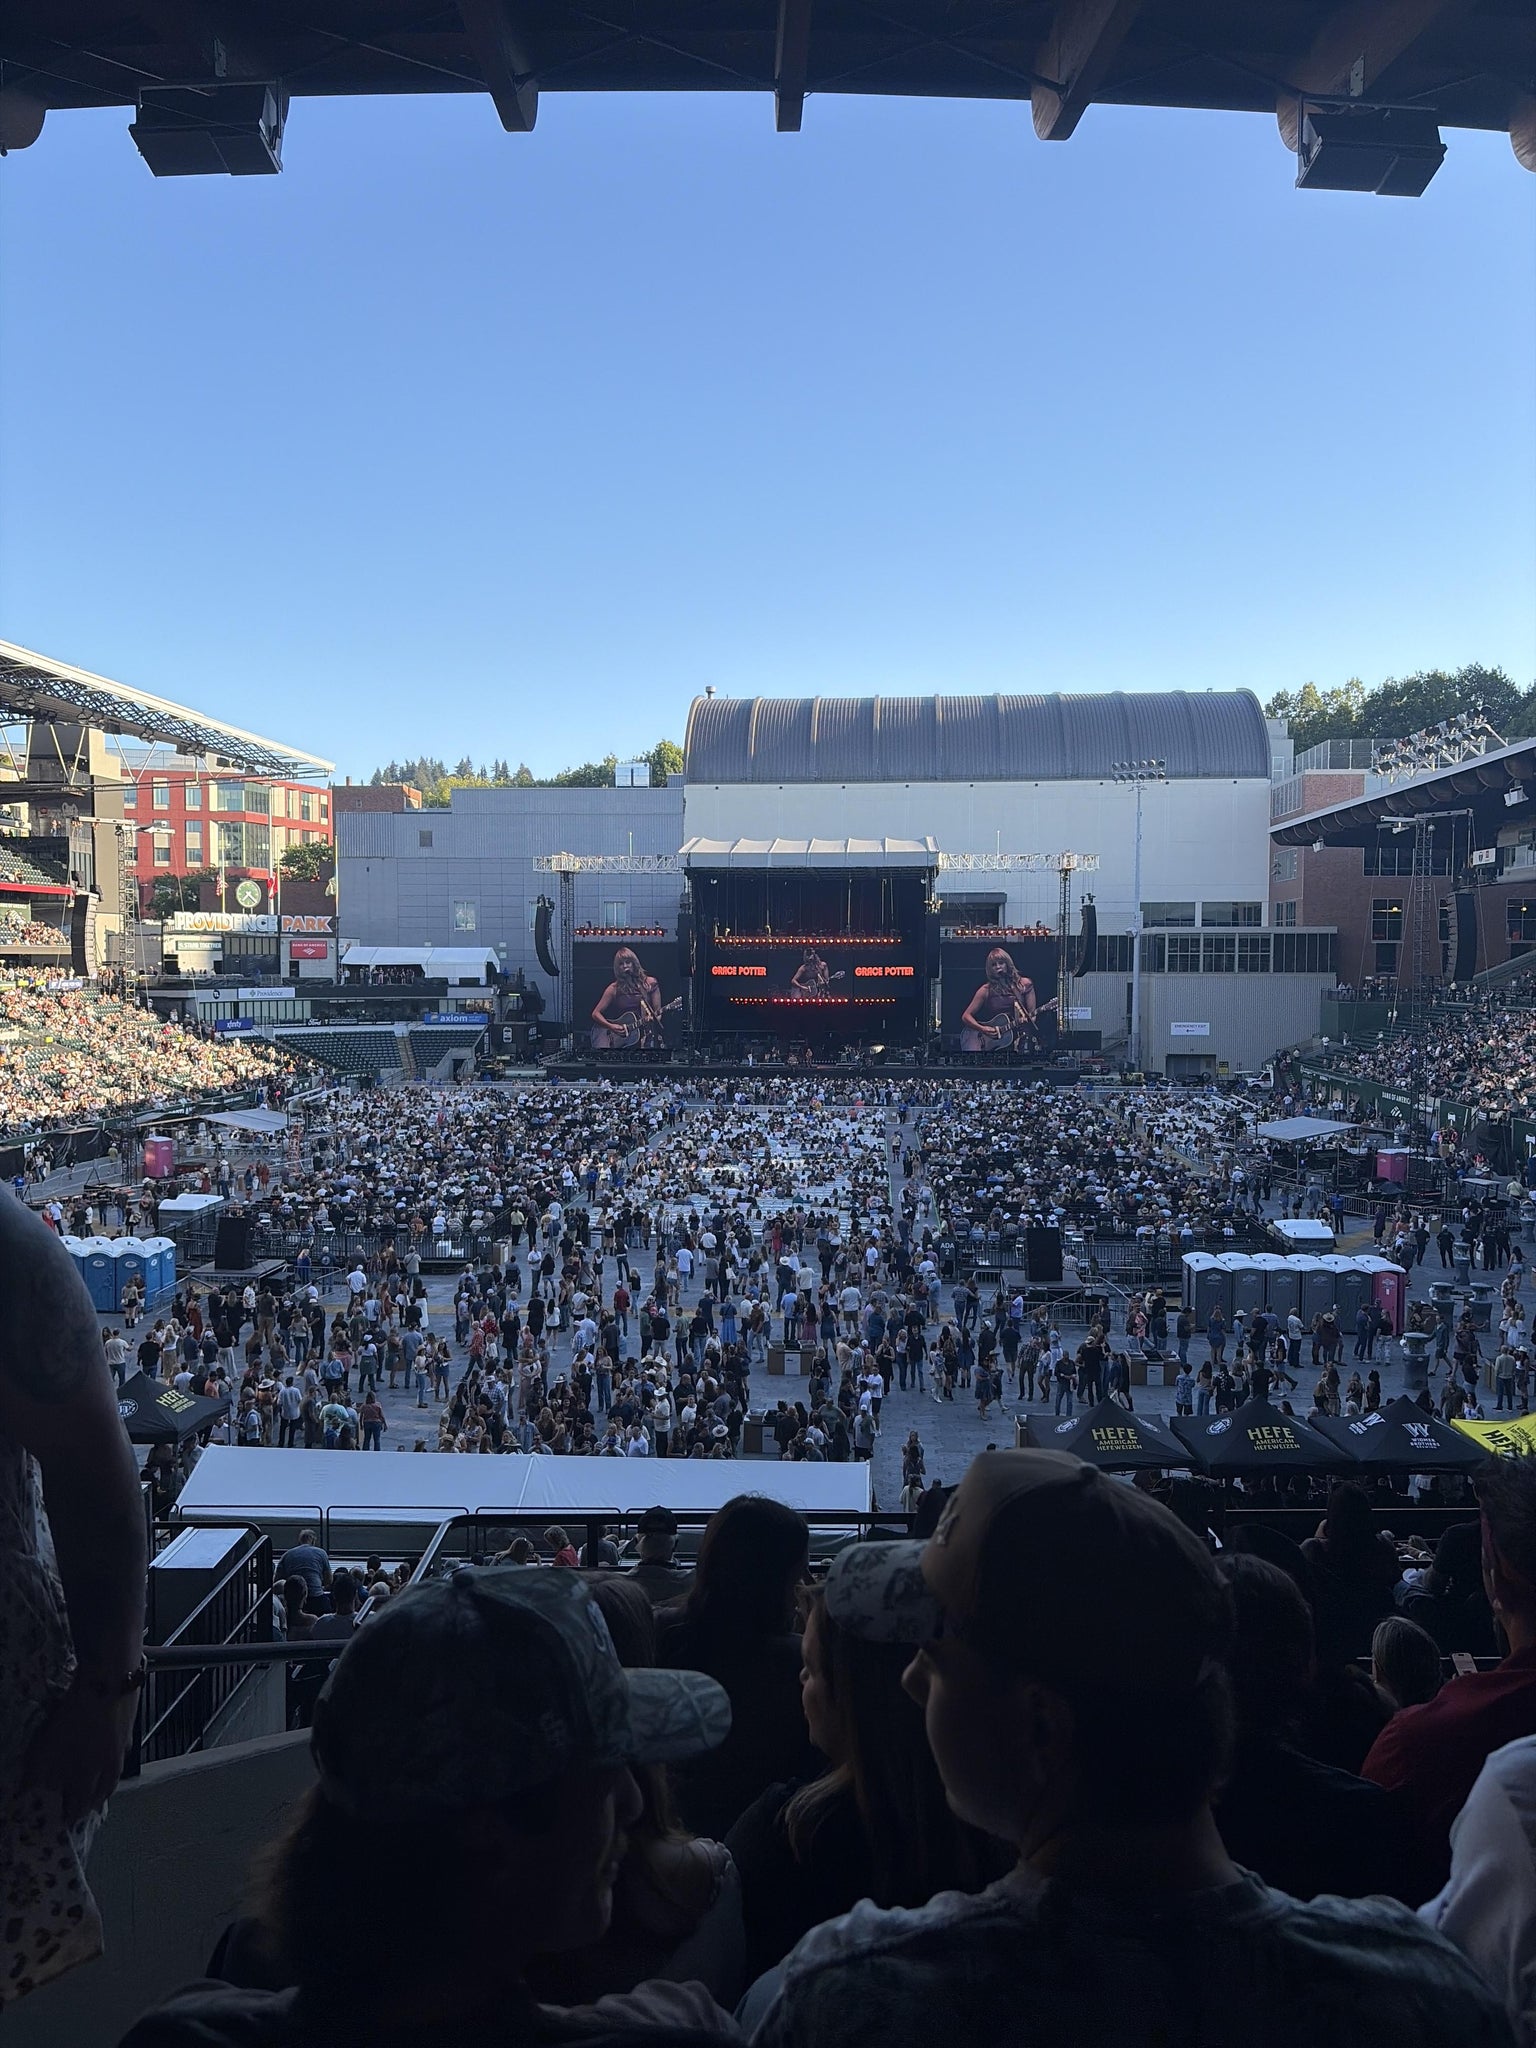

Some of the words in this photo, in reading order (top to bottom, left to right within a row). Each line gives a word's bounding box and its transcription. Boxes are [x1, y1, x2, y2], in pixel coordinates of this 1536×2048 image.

[174, 911, 278, 932] PROVIDENCE
[281, 915, 333, 933] PARK
[712, 966, 738, 976] GRACE
[738, 966, 767, 976] POTTER
[855, 966, 884, 976] GRACE
[884, 966, 914, 976] POTTER
[440, 1014, 468, 1022] axiom
[226, 1020, 242, 1028] xfinity
[1382, 1091, 1392, 1100] BANK
[156, 1390, 184, 1406] HEFE
[1092, 1427, 1138, 1440] HEFE
[1247, 1426, 1294, 1440] HEFE
